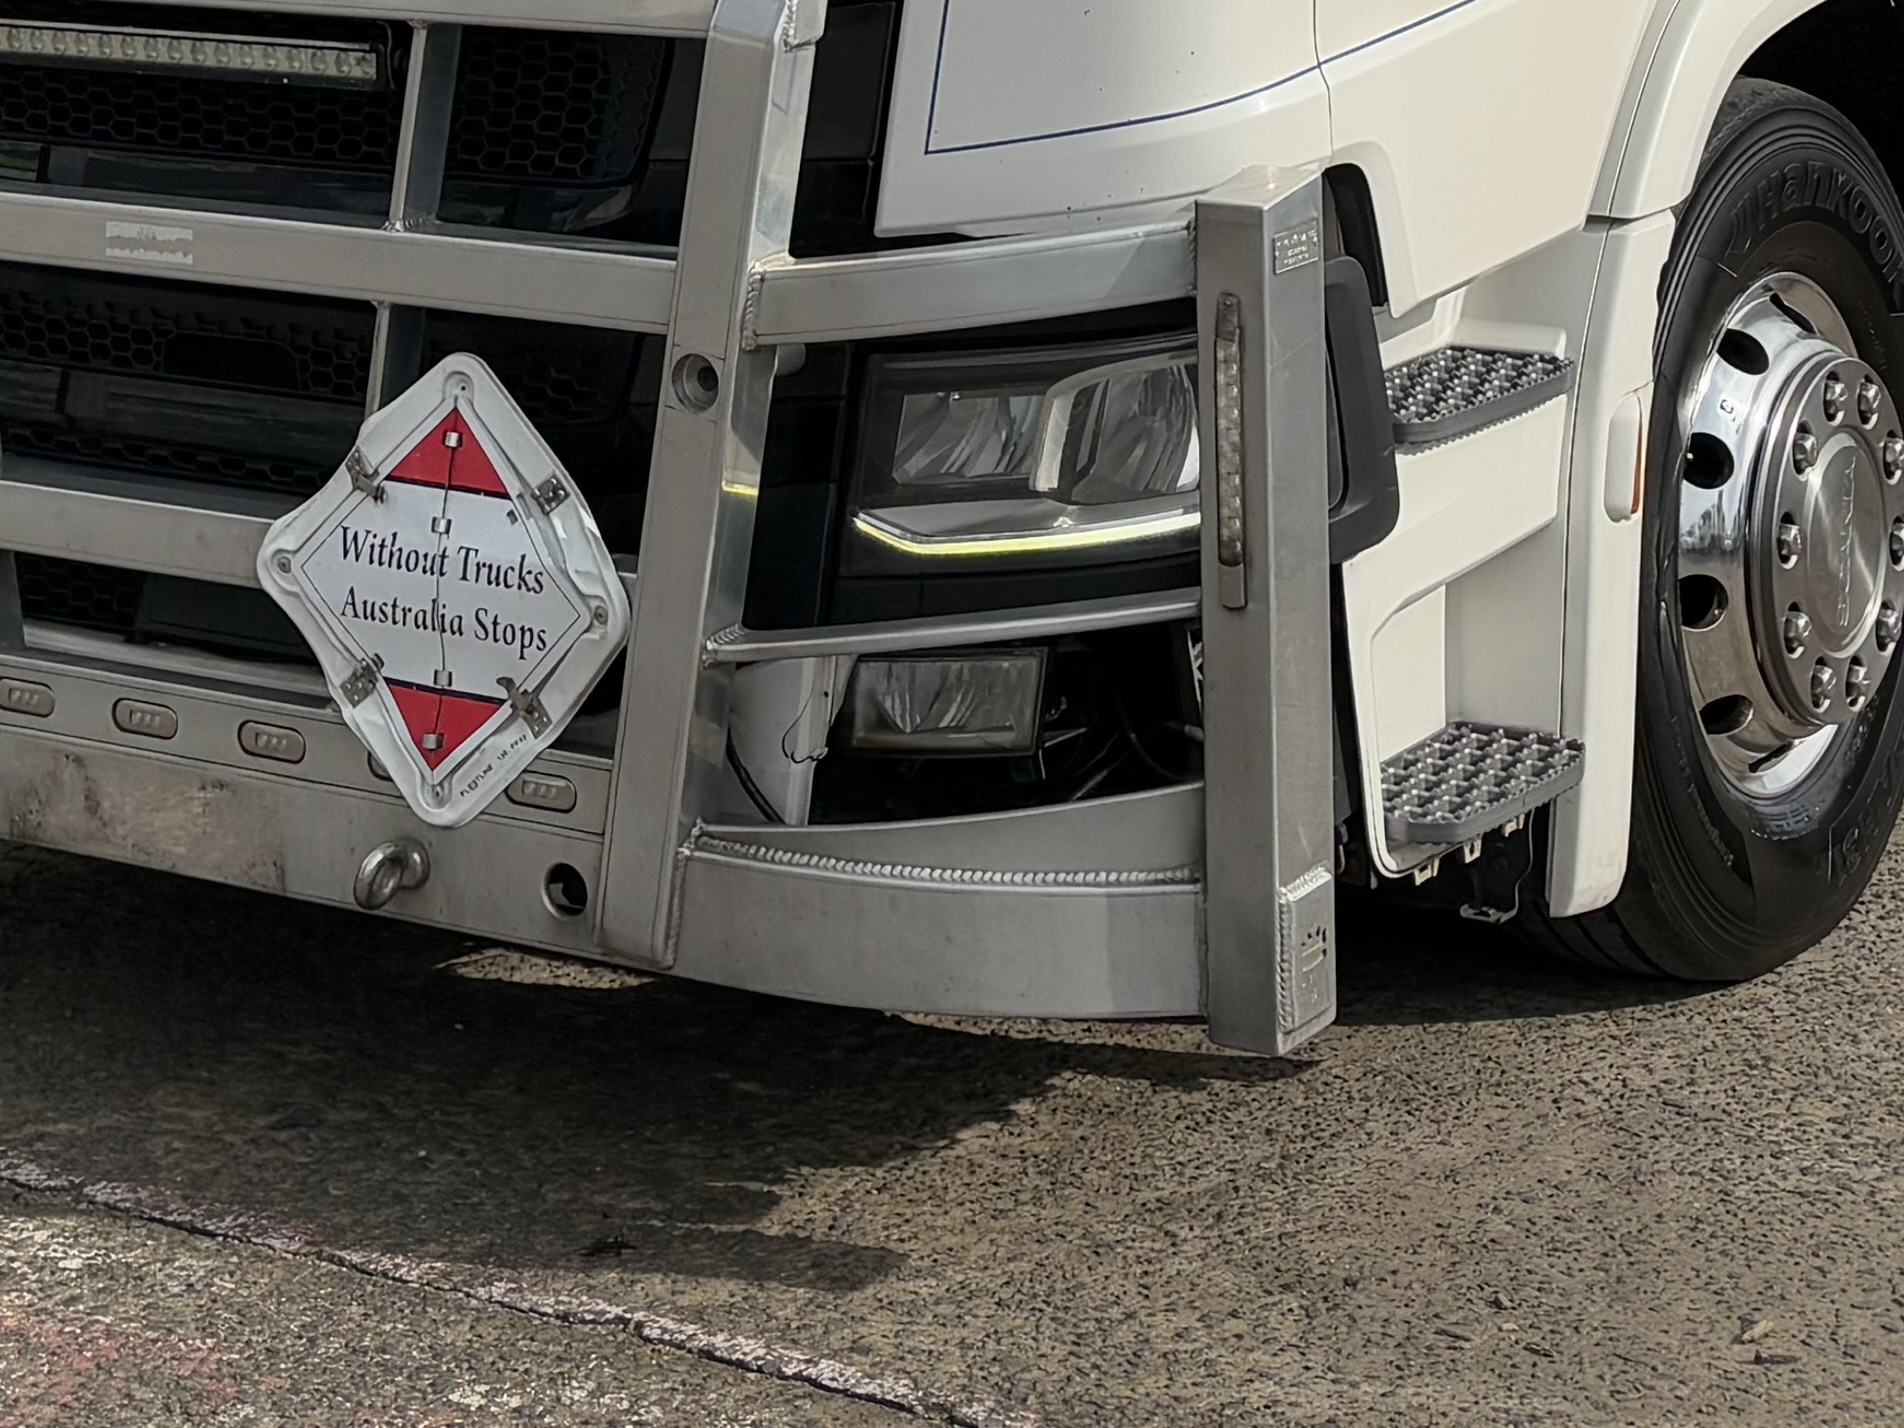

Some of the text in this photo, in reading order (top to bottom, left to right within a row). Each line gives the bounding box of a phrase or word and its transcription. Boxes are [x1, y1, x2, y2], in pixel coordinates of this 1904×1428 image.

[340, 524, 545, 597] Without Trucks
[340, 585, 548, 661] Australia Stops
